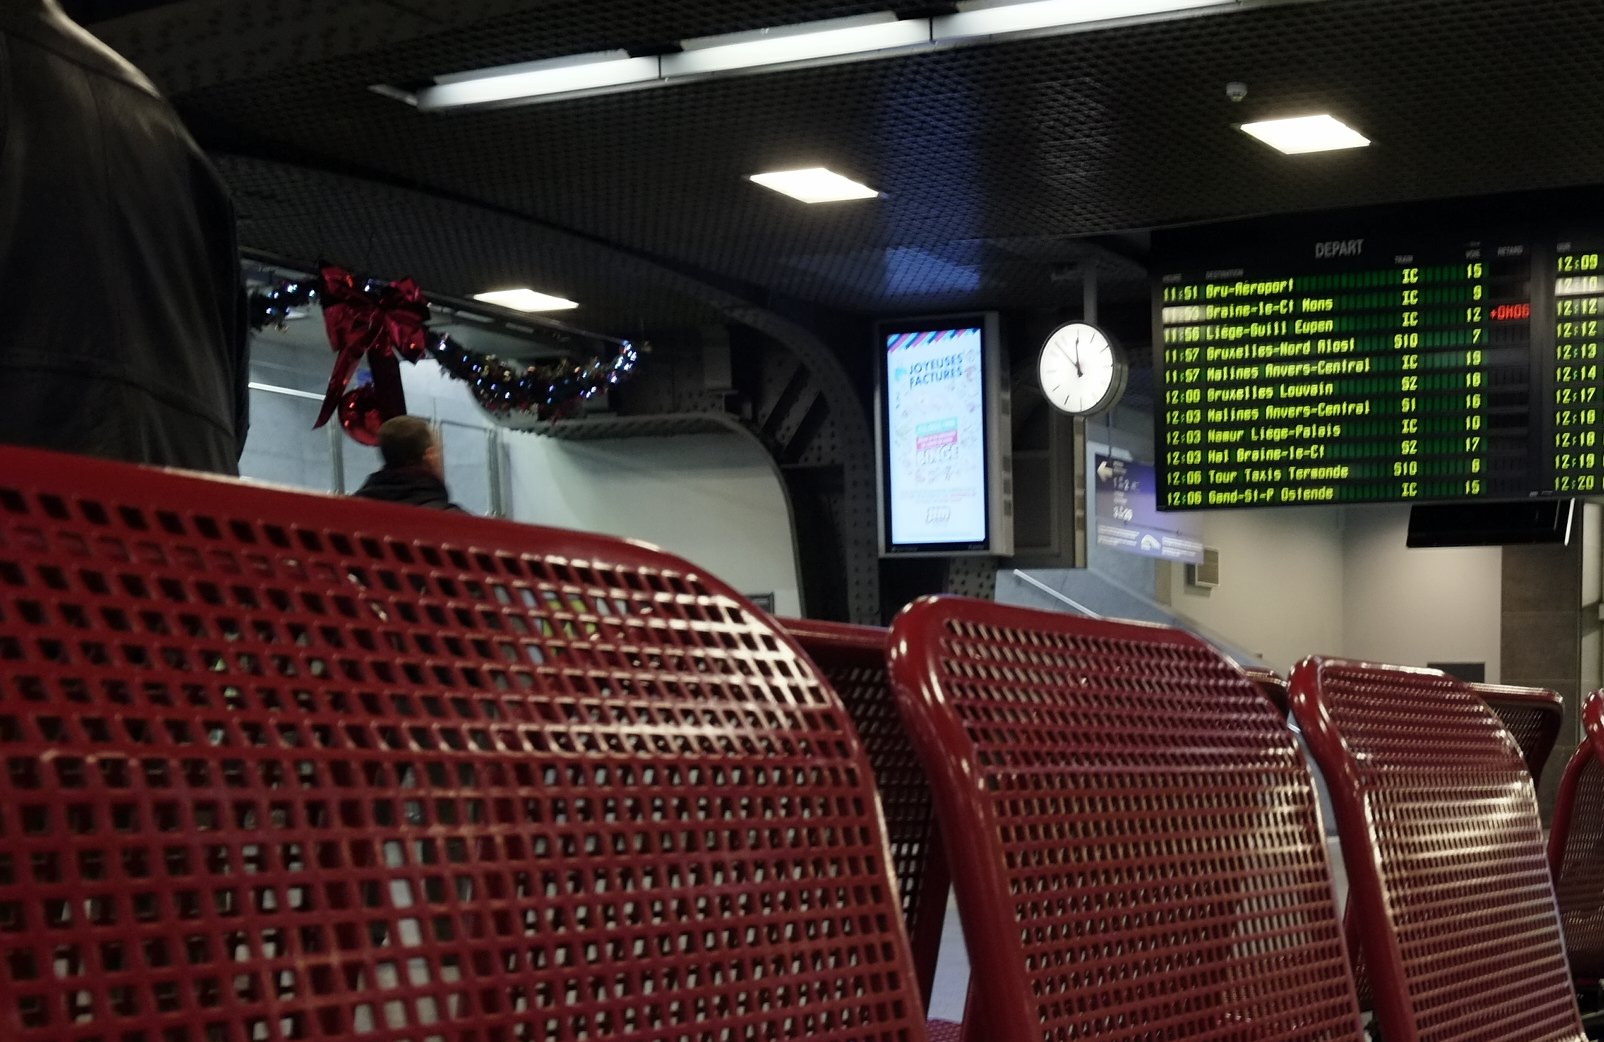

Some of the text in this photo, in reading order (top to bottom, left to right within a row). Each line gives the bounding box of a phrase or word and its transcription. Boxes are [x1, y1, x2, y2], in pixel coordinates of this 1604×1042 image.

[1315, 239, 1365, 259] DEPART
[1402, 267, 1419, 284] IC
[1206, 299, 1294, 320] Braine-le-Ct
[1294, 319, 1334, 335] Eupen
[1401, 311, 1419, 327] IC
[1206, 340, 1311, 361] Bruxelles-Nord
[908, 352, 964, 376] JOYEUSES
[1206, 366, 1259, 382] Malines
[1265, 357, 1371, 378] Anvers-Central
[1401, 354, 1418, 370] IC
[908, 366, 964, 390] FACTURES
[1207, 385, 1274, 403] Bruxelles
[1280, 381, 1334, 399] Louvain
[1207, 407, 1259, 423] Malines
[1265, 400, 1370, 420] Anvers-Central
[1207, 429, 1245, 443] Namur
[1236, 444, 1325, 463] Braine-le-Ct
[1288, 464, 1349, 481] Termonde
[1208, 486, 1334, 505] Gand-St-P Ostende
